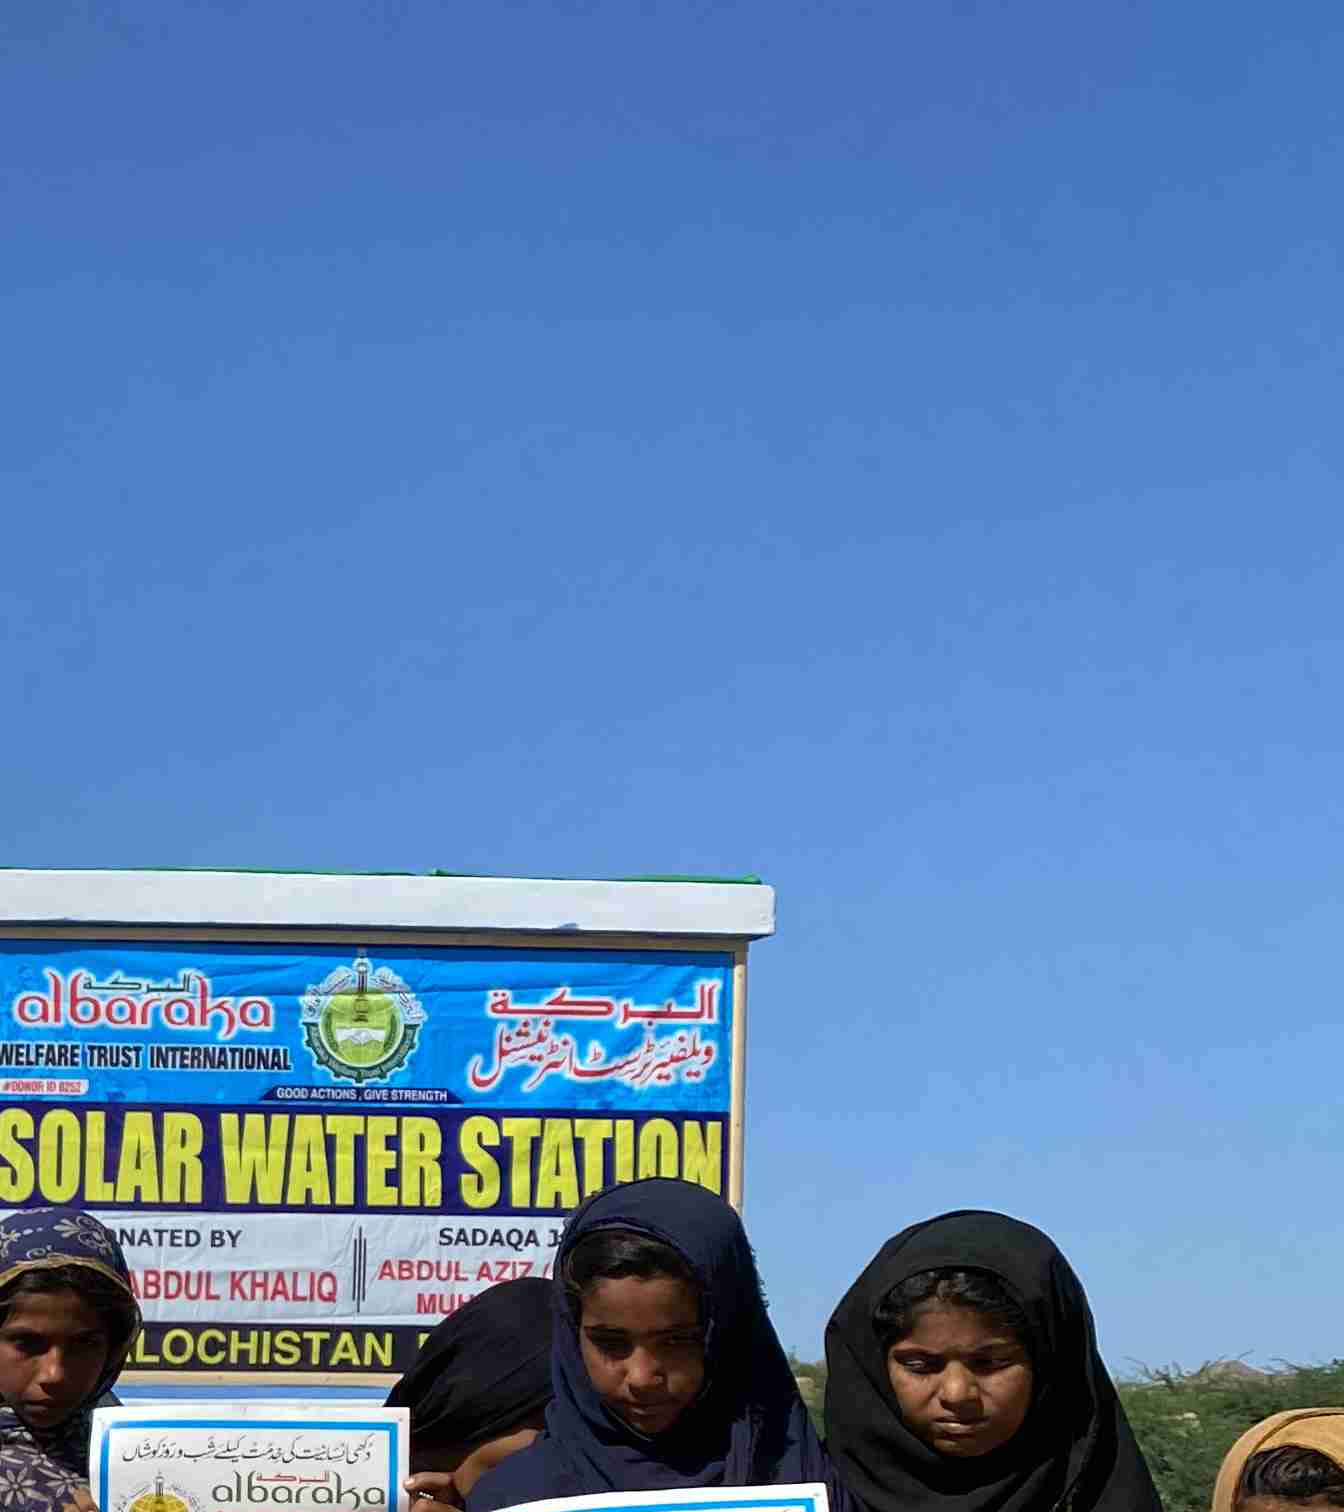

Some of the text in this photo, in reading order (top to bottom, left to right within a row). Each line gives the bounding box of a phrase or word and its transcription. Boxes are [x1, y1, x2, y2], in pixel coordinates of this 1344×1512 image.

[17, 971, 272, 1038] albaraka
[88, 1045, 142, 1068] TRUST
[150, 1045, 292, 1071] INTERNATIONAL
[277, 1088, 308, 1099] GOOD
[364, 1089, 389, 1100] GIVE
[391, 1090, 447, 1102] STRENGTH
[219, 1112, 442, 1207] WATER
[459, 1115, 723, 1209] STATION
[112, 1228, 243, 1248] NATED BY
[439, 1228, 540, 1251] SADAQA
[378, 1260, 468, 1281] ABDUL
[475, 1261, 532, 1281] AZIZ
[230, 1270, 337, 1303] KHALIQ
[127, 1328, 393, 1367] LOCHISTAN
[212, 1470, 385, 1510] albaraka
